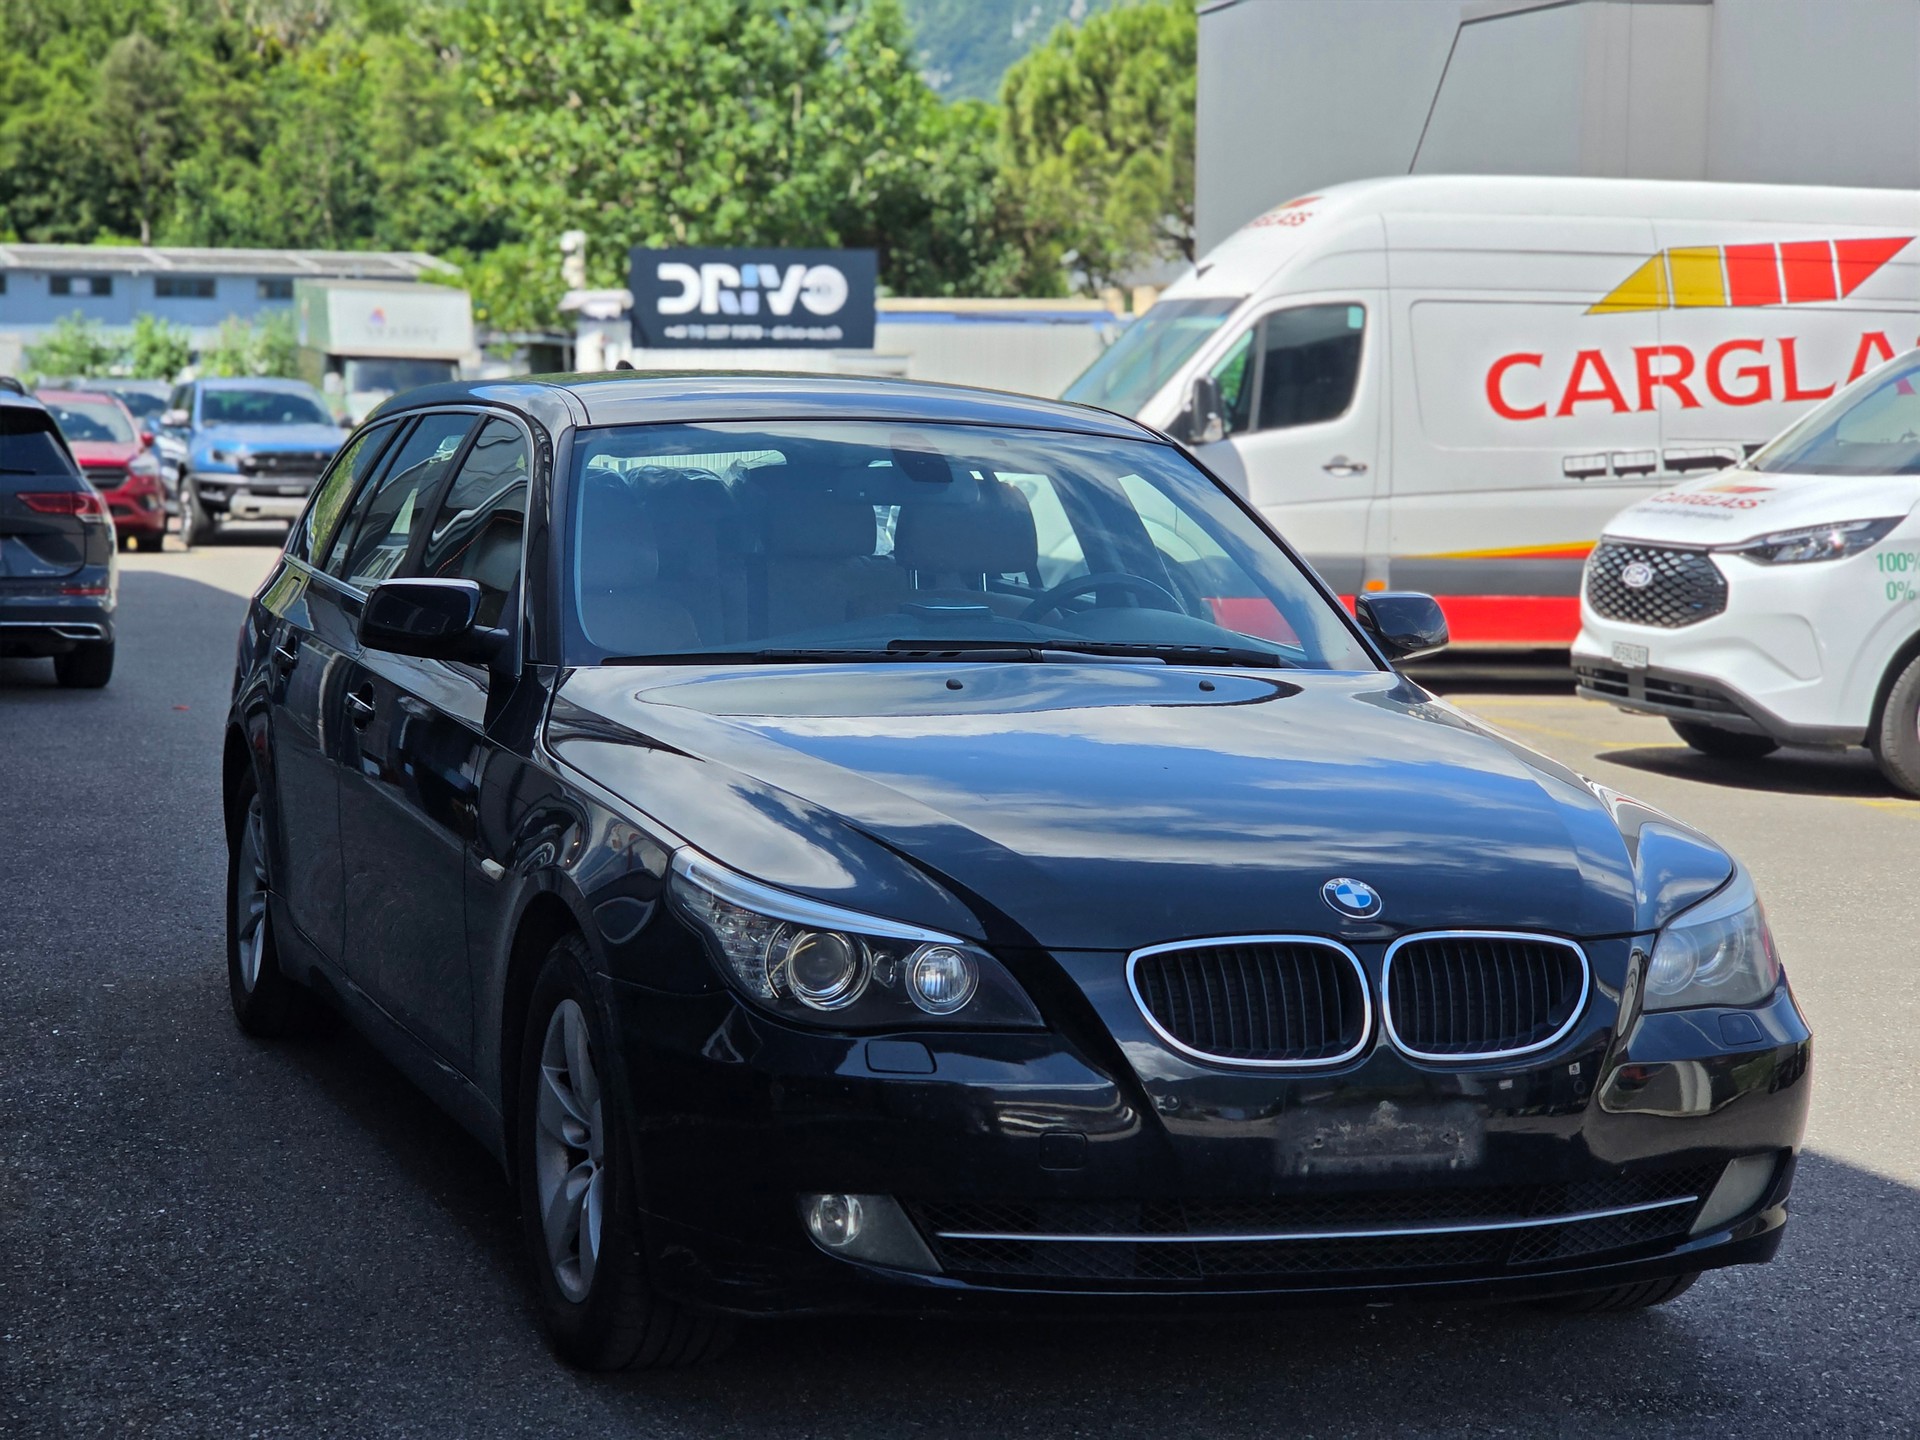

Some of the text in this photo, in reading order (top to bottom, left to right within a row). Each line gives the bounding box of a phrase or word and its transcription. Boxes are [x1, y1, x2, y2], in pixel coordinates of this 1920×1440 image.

[657, 262, 849, 316] DRIVO
[1485, 330, 1920, 421] CARGLA
[1886, 580, 1916, 601] 0%
